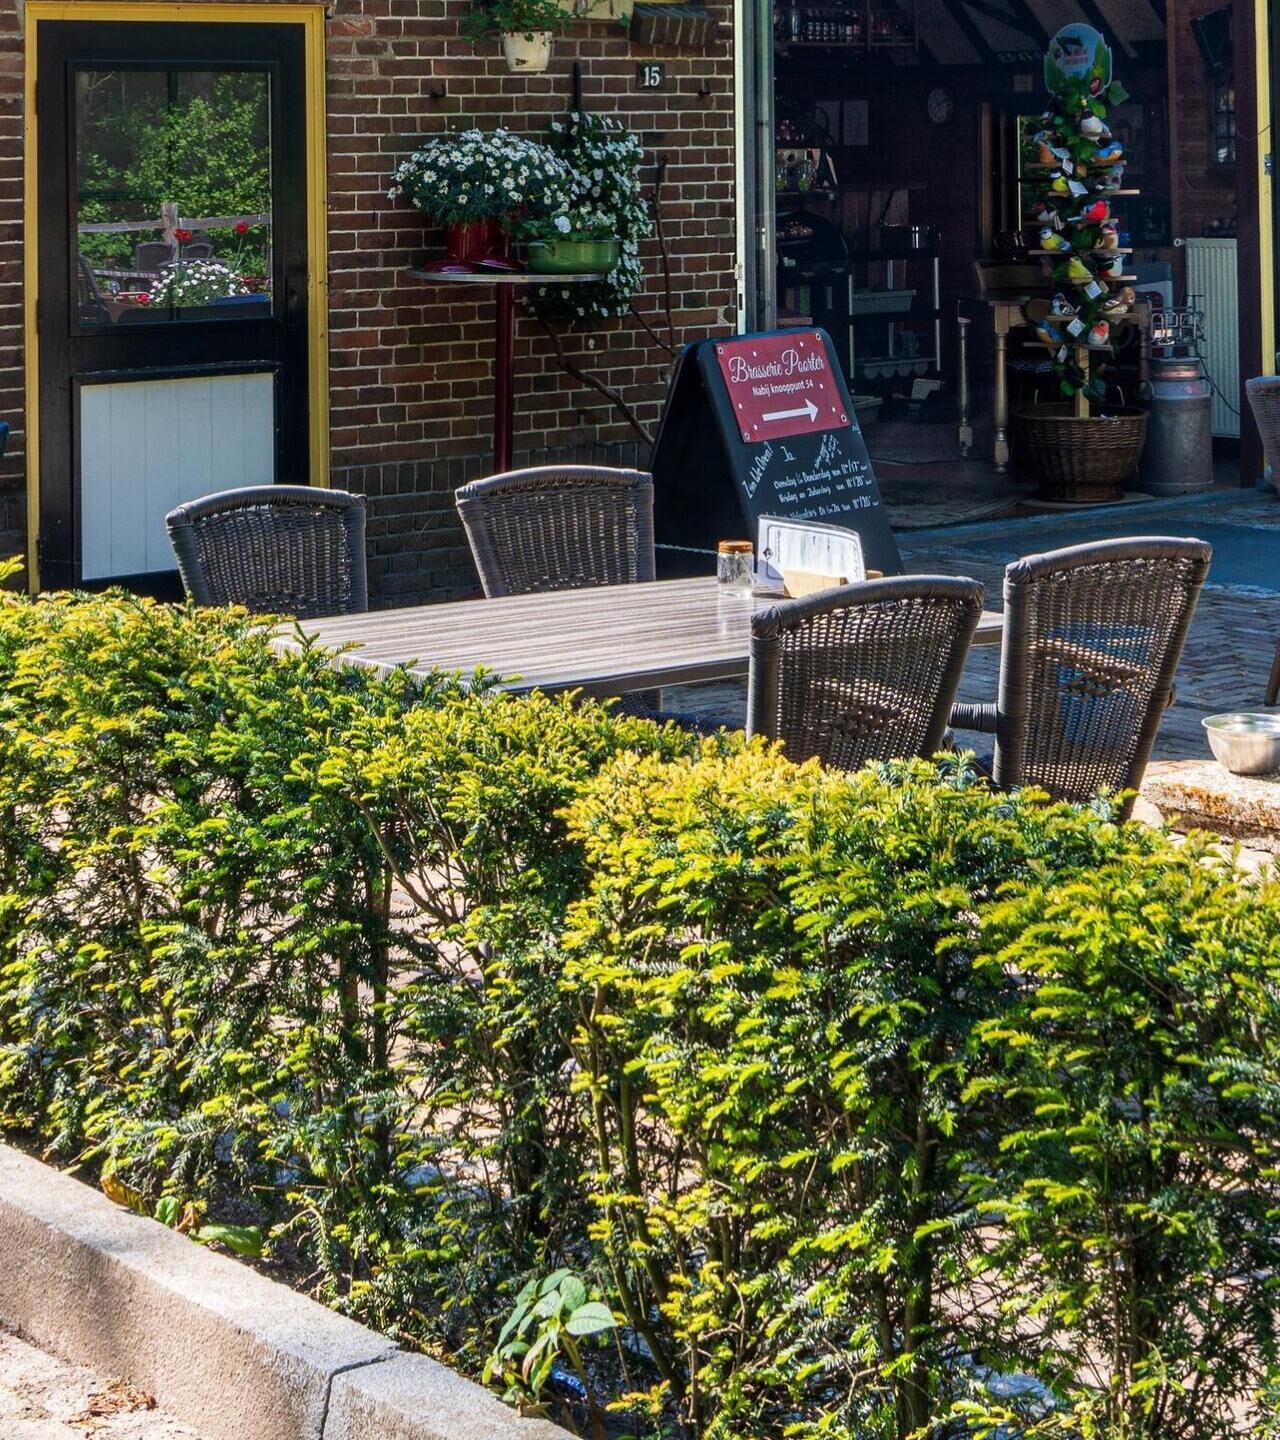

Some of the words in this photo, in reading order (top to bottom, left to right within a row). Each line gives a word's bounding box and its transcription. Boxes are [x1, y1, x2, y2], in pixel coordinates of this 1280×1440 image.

[643, 66, 660, 87] 15
[728, 356, 783, 383] Brasserie
[751, 383, 771, 397] Nabij
[770, 380, 806, 395] knooppunt
[805, 378, 814, 389] 54
